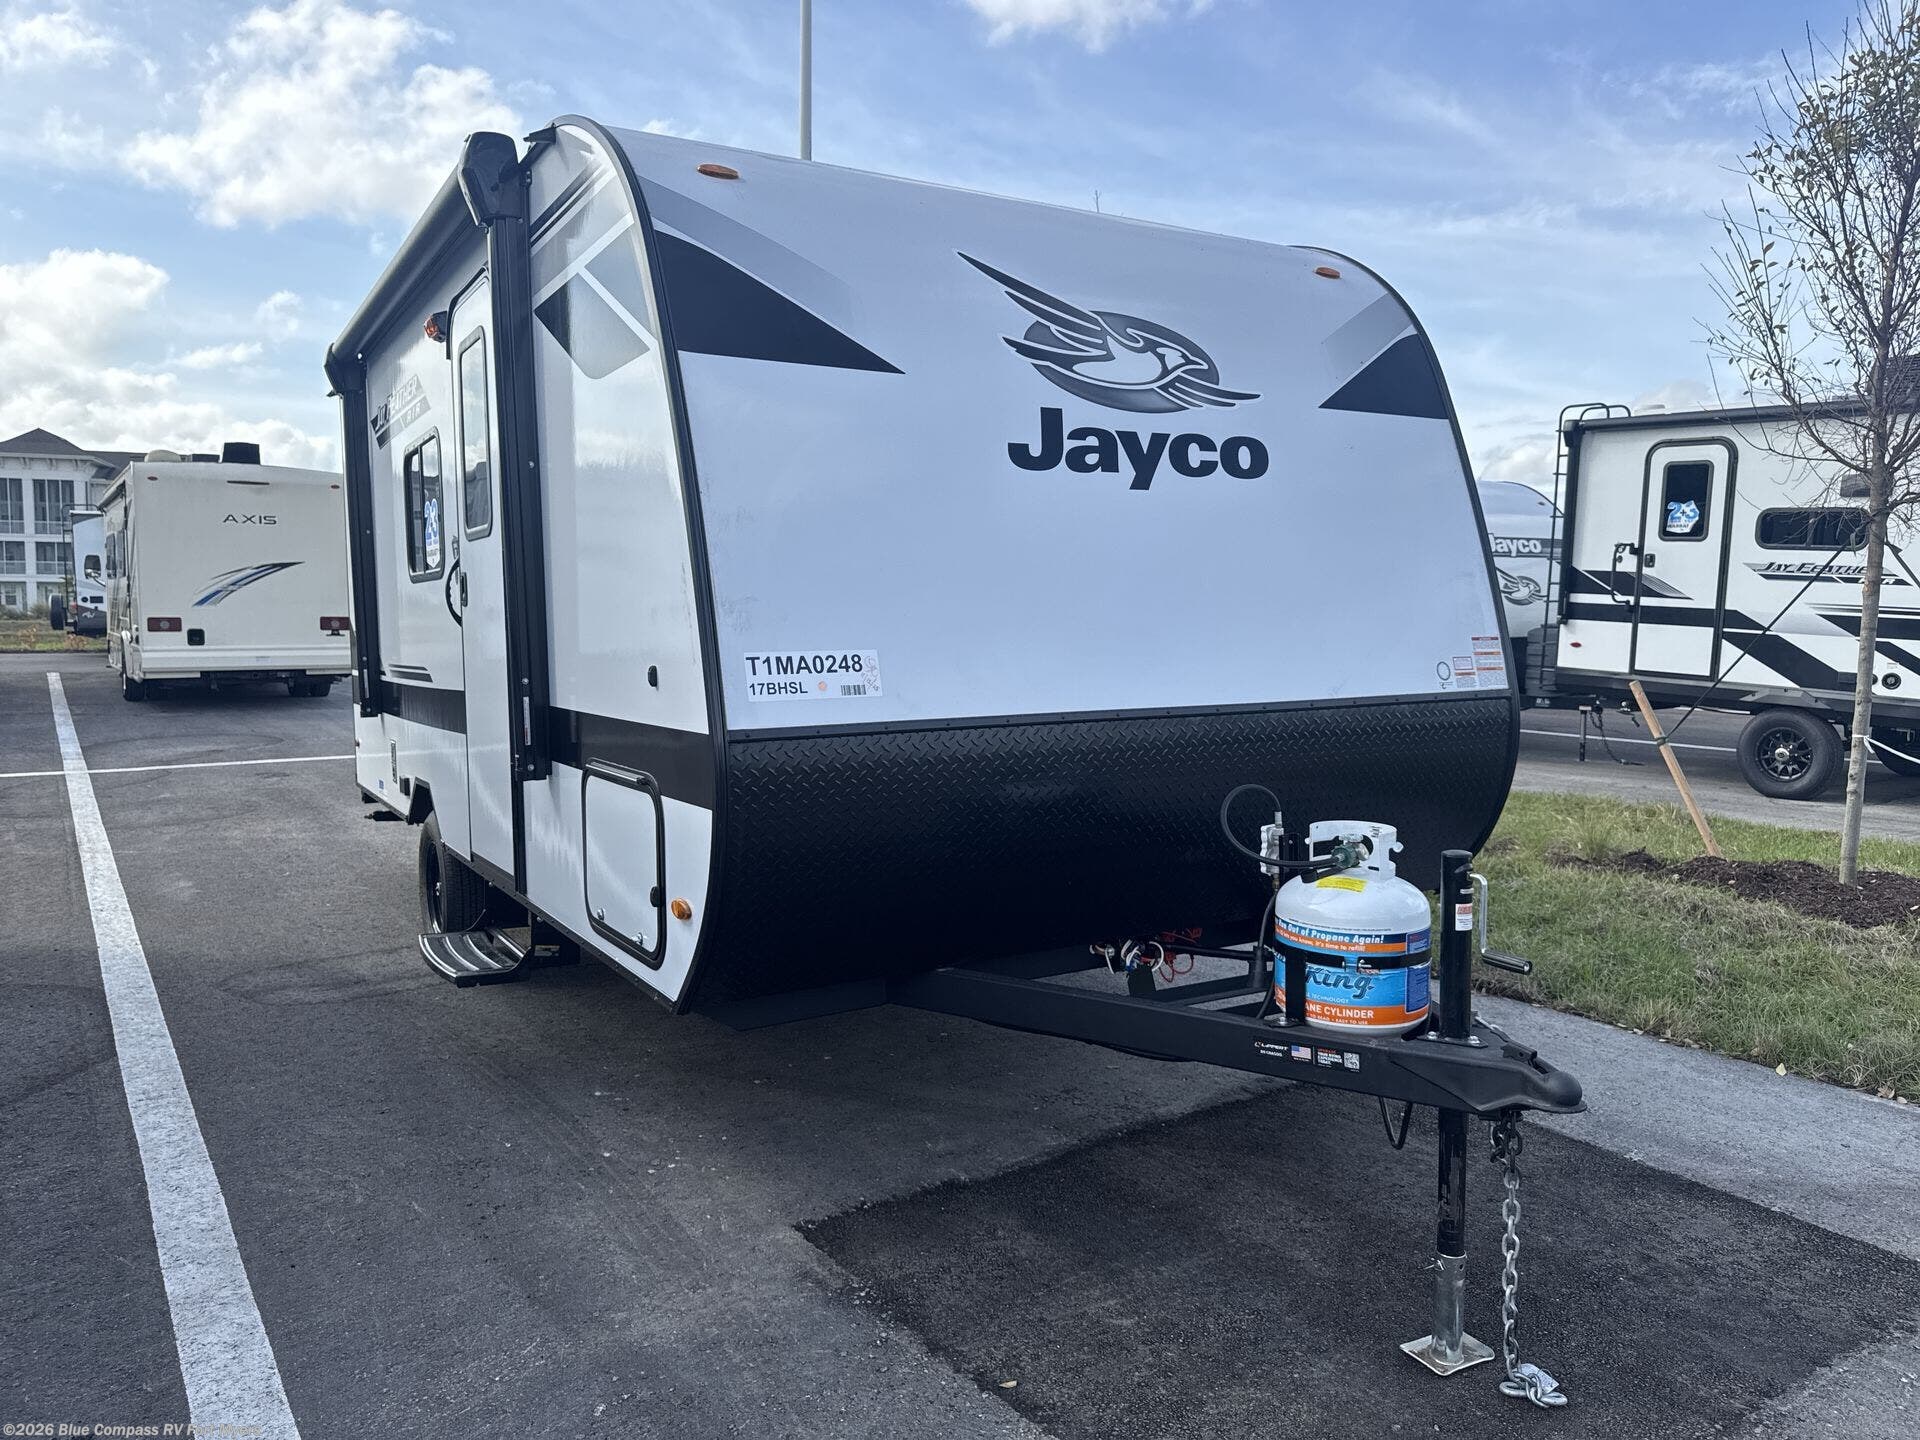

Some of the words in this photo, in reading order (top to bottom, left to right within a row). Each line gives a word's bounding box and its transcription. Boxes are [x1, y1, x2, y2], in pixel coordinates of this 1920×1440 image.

[1007, 406, 1270, 491] Jayco
[222, 513, 278, 525] AXIS
[1796, 562, 1869, 575] FEATHE
[745, 653, 863, 676] T1MA0248
[749, 681, 809, 695] 17BHSL
[1300, 928, 1309, 937] of
[1311, 930, 1350, 943] Propane
[1353, 934, 1384, 946] Again!
[1305, 965, 1374, 1000] King
[1311, 993, 1349, 1004] TECHNOLOGY
[1305, 1003, 1322, 1014] ANE
[1324, 1006, 1374, 1019] CYLINDER
